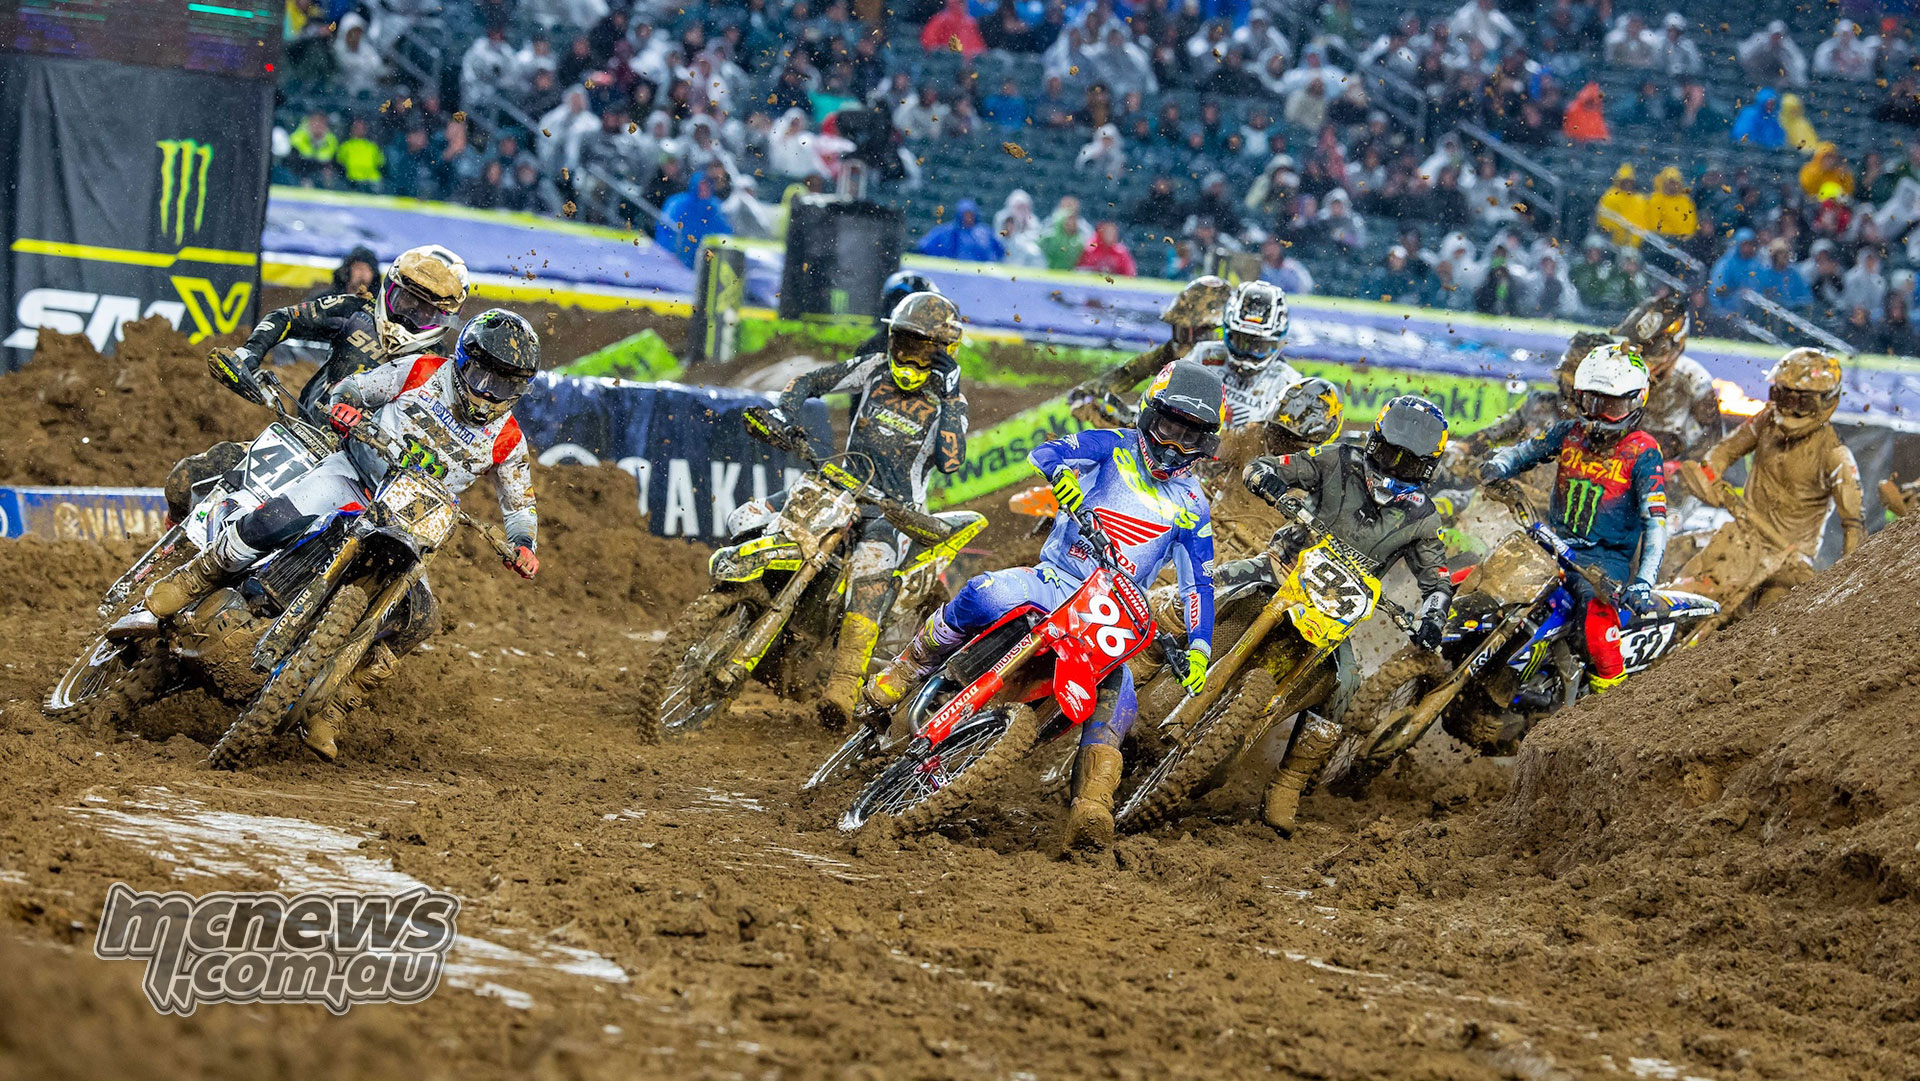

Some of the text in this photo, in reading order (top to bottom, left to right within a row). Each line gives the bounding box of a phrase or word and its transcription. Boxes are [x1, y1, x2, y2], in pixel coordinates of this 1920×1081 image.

[438, 411, 475, 445] YAMAHA
[1367, 440, 1378, 455] FOX
[250, 443, 310, 492] 41
[1423, 463, 1434, 480] FOX
[1115, 576, 1148, 621] RENTHAL
[1305, 561, 1363, 617] 94
[1076, 593, 1137, 658] 96
[1624, 630, 1663, 668] 32
[933, 683, 980, 730] DUNLOP
